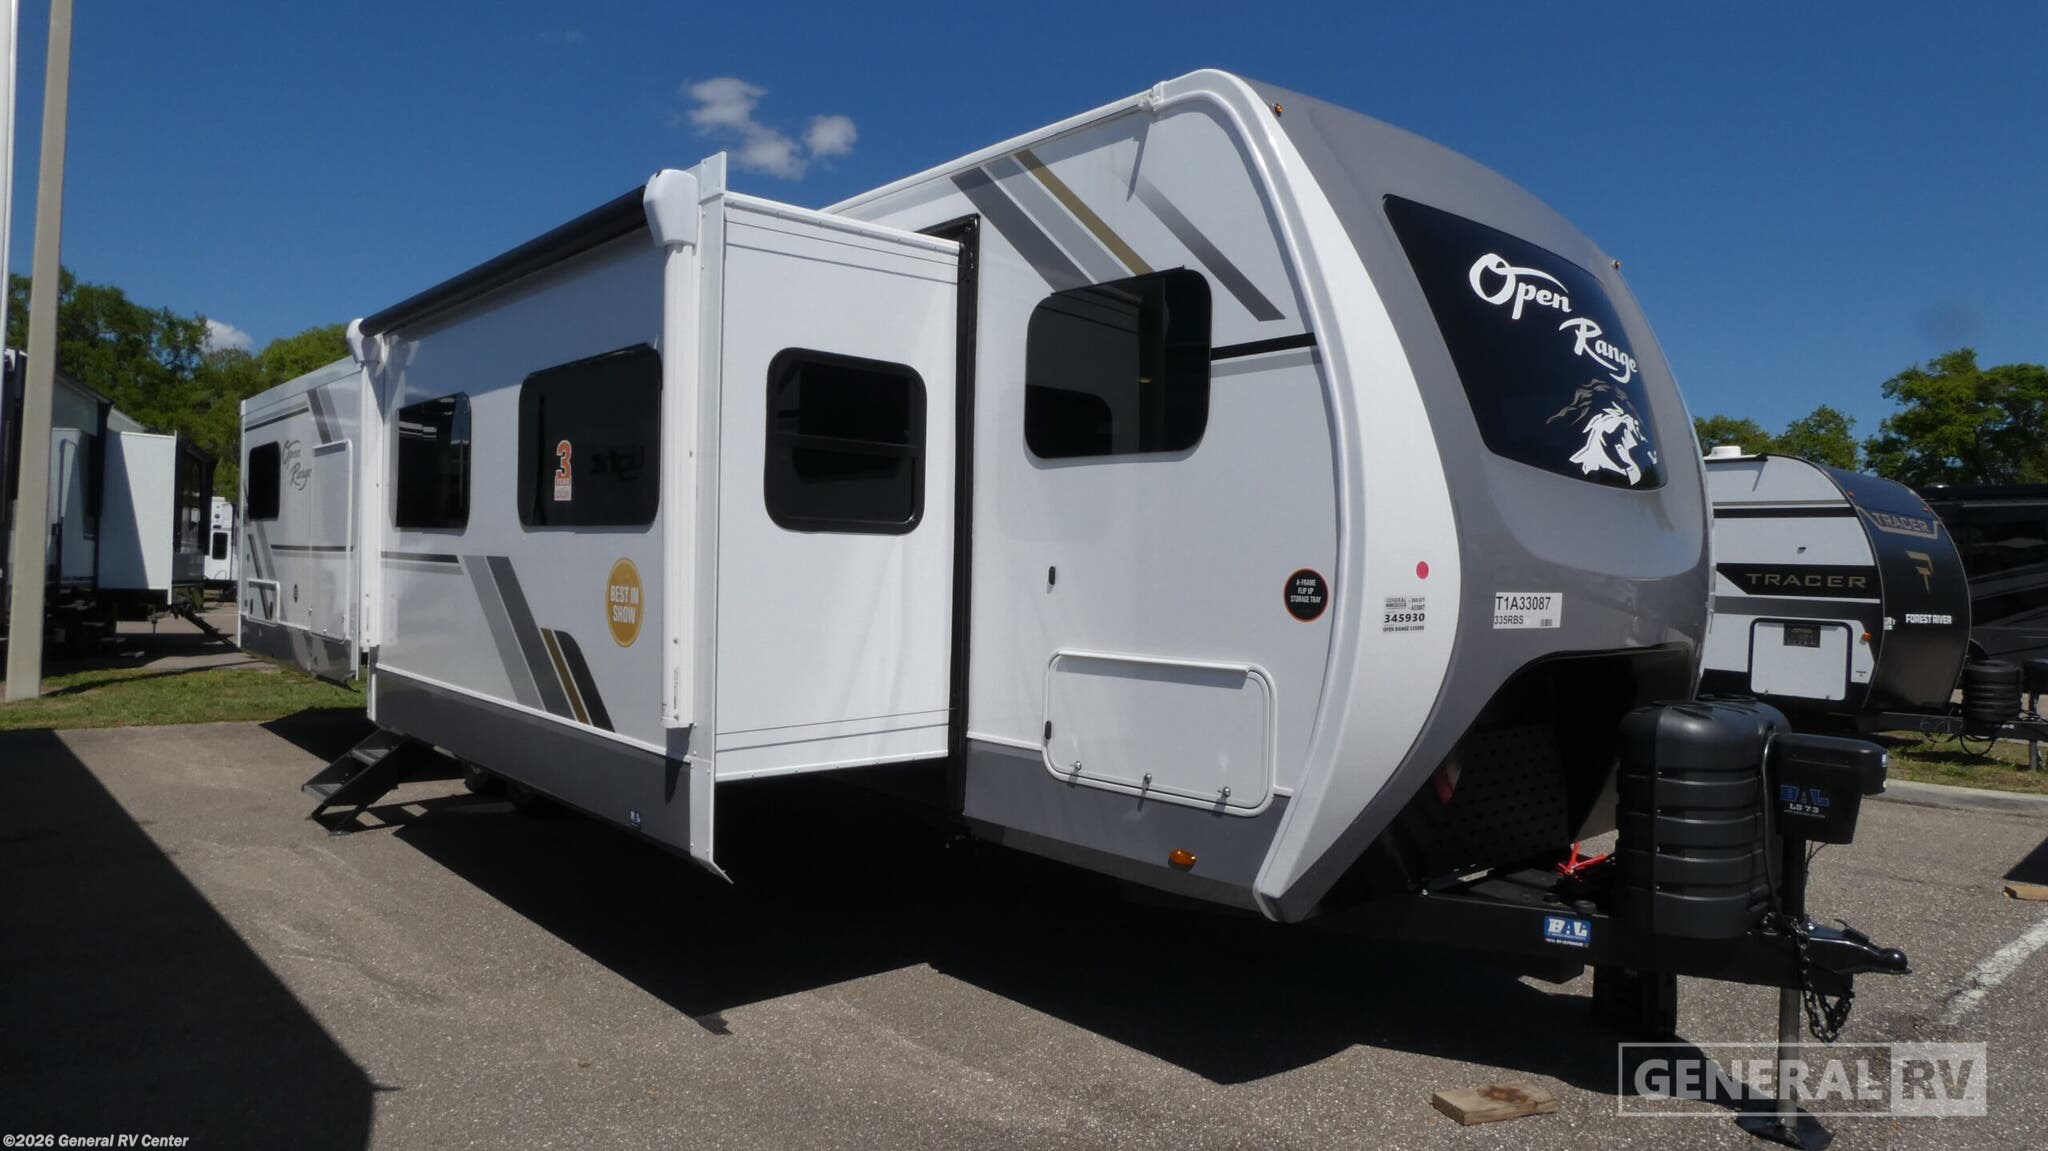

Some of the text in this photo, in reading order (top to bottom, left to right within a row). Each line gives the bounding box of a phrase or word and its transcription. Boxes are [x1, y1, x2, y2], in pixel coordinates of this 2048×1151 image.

[1469, 253, 1571, 319] Open
[1558, 317, 1637, 383] Range
[556, 440, 572, 478] 3
[1872, 512, 1929, 531] TRACER
[1747, 573, 1867, 588] TRACER
[610, 585, 639, 604] BEST IN
[1496, 596, 1551, 610] T1A33087
[612, 605, 636, 624] SHOW
[1384, 613, 1425, 623] 345930
[1494, 615, 1524, 624] 335RBS
[1905, 614, 1952, 624] FOREST RIVER
[1789, 803, 1820, 813] LS 73
